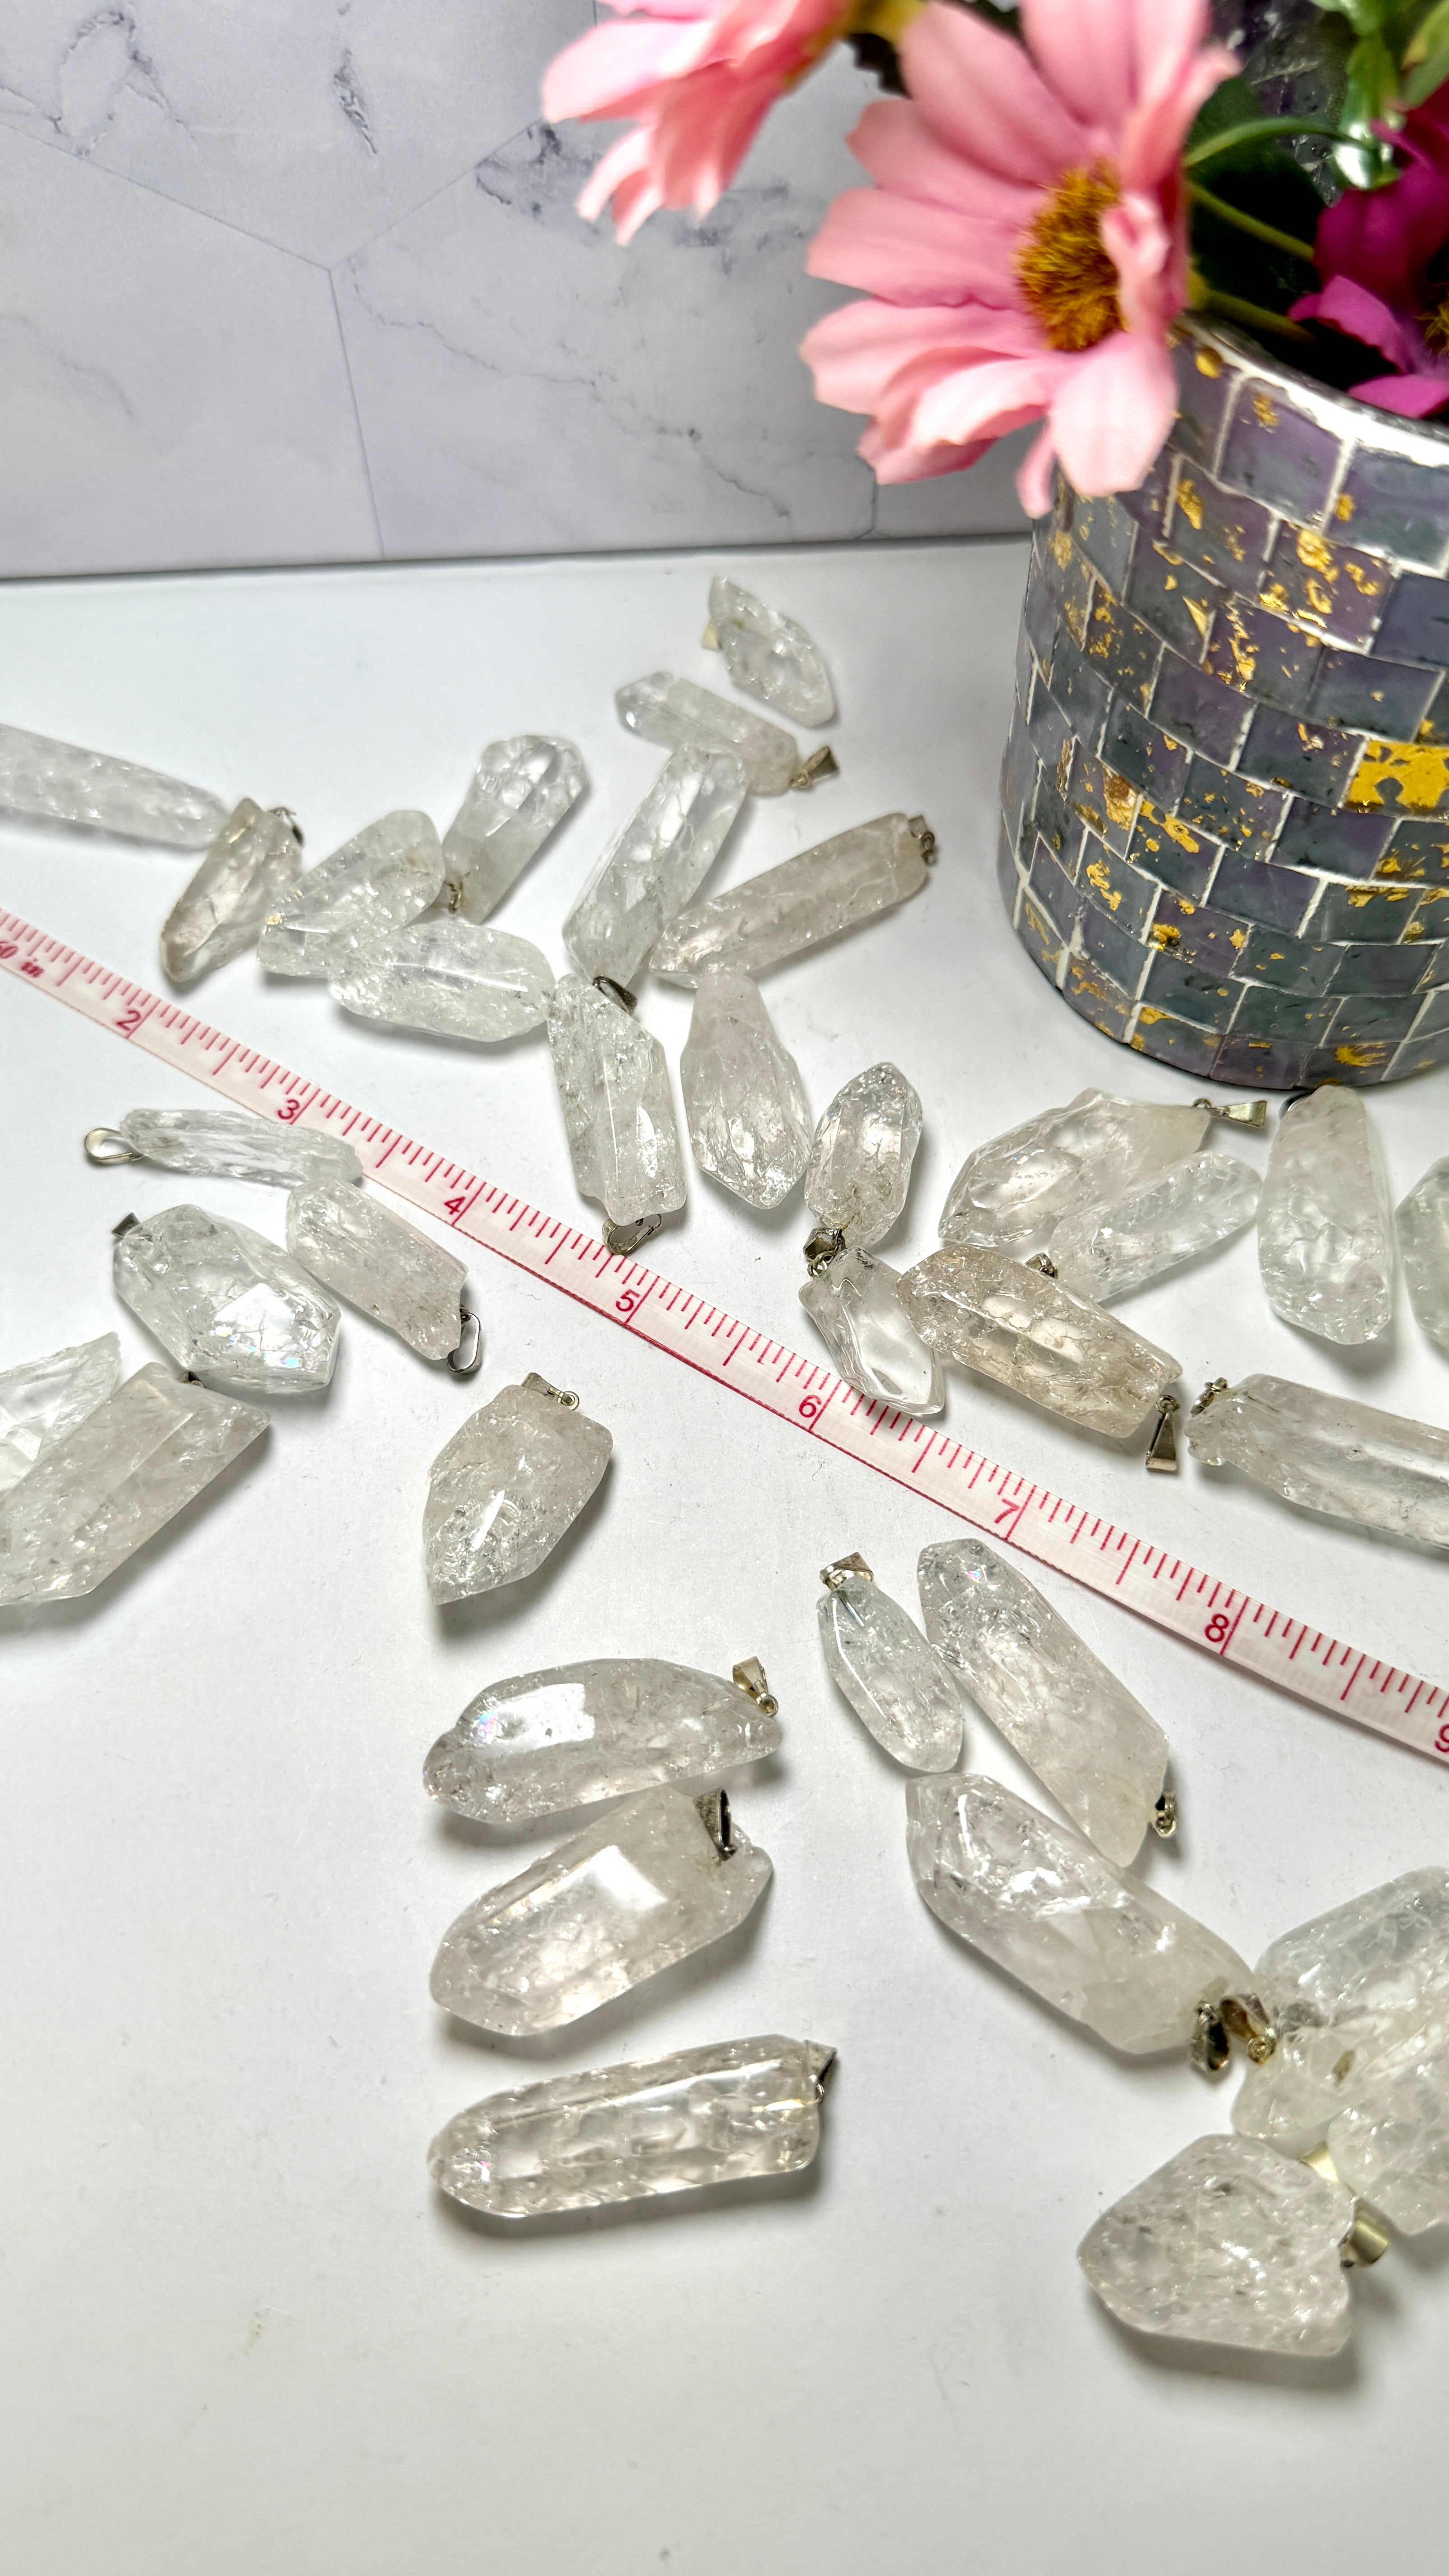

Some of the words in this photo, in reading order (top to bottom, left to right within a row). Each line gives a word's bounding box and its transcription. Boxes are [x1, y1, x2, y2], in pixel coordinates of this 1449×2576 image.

[116, 1010, 141, 1031] 2
[277, 1099, 300, 1120] 3
[444, 1196, 466, 1214] 4
[616, 1289, 640, 1312] 5
[799, 1395, 821, 1418] 6
[994, 1498, 1020, 1524] 7
[1204, 1614, 1229, 1642] 8
[1434, 1724, 1449, 1753] 9
